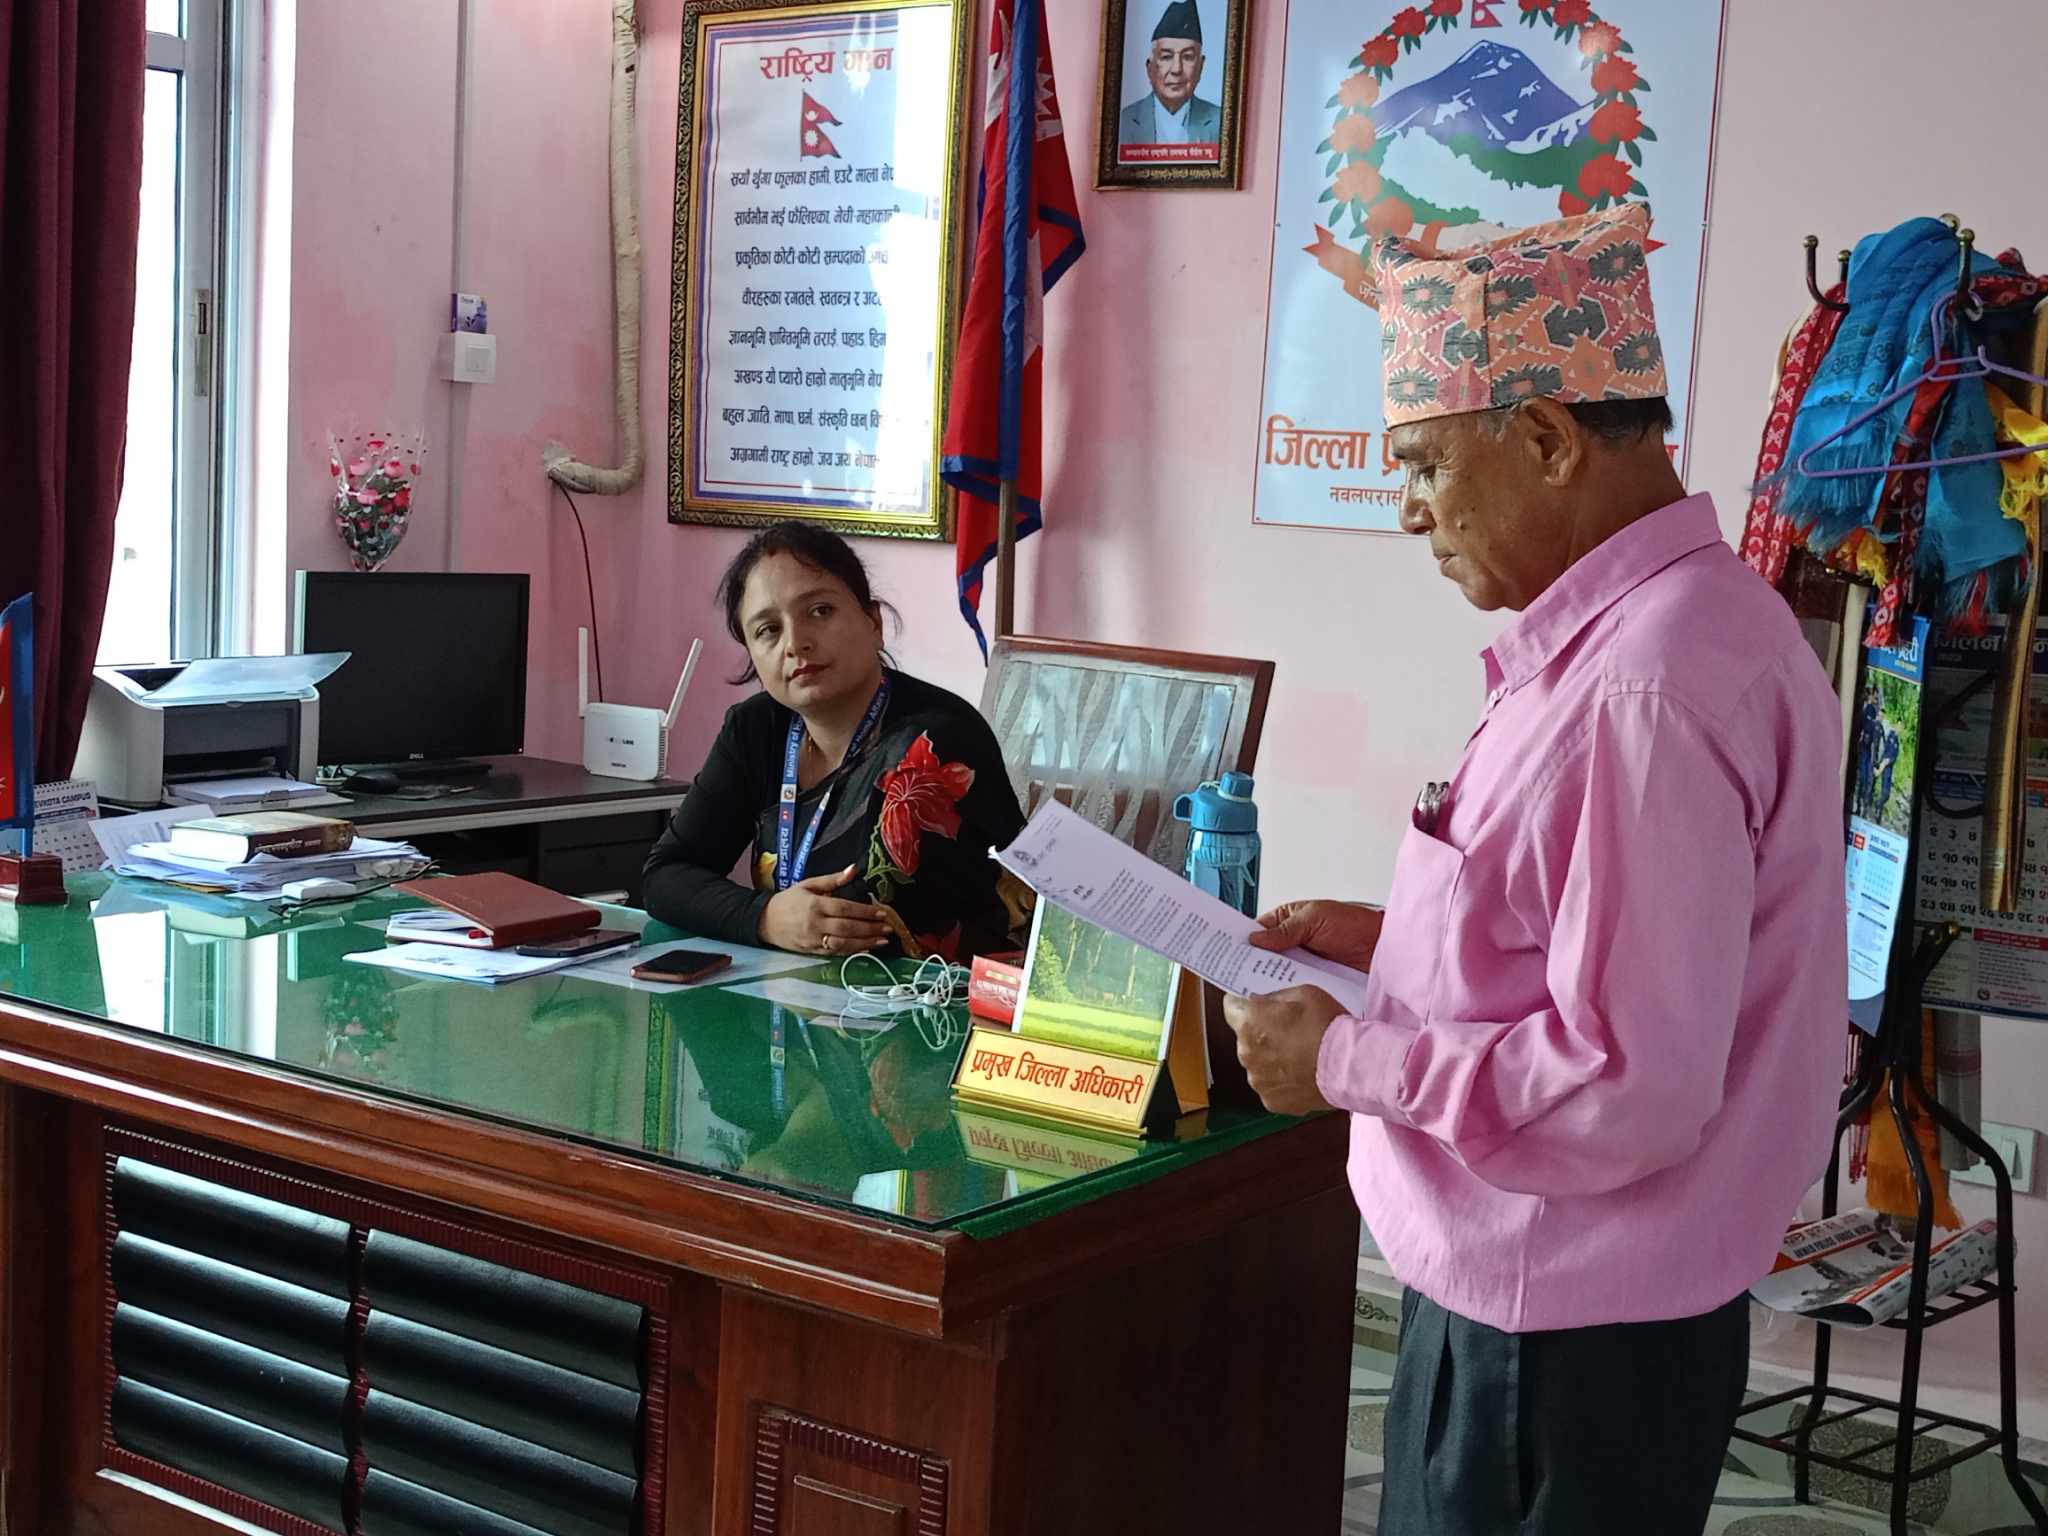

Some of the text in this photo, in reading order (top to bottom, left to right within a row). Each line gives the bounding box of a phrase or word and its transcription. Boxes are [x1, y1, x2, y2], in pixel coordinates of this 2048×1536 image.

[760, 47, 836, 82] राष्ट्रिय
[854, 291, 860, 306] र
[765, 366, 776, 384] यो
[1265, 414, 1403, 476] जिल्ला प्र
[786, 741, 800, 778] Ministry
[1929, 827, 1937, 837] २
[1949, 828, 1957, 840] ३
[1968, 831, 1977, 841] ४
[1943, 852, 1958, 863] १०
[1962, 854, 1978, 866] ११
[1922, 874, 1937, 886] १६
[1941, 877, 1957, 888] १७
[1962, 879, 1977, 890] १८
[1920, 899, 1936, 910] २३
[1940, 901, 1955, 912] २४
[1960, 903, 1976, 914] २५
[2018, 911, 2033, 922] २८
[970, 1048, 1144, 1104] प्रमुख जिल्ला अधिकारी
